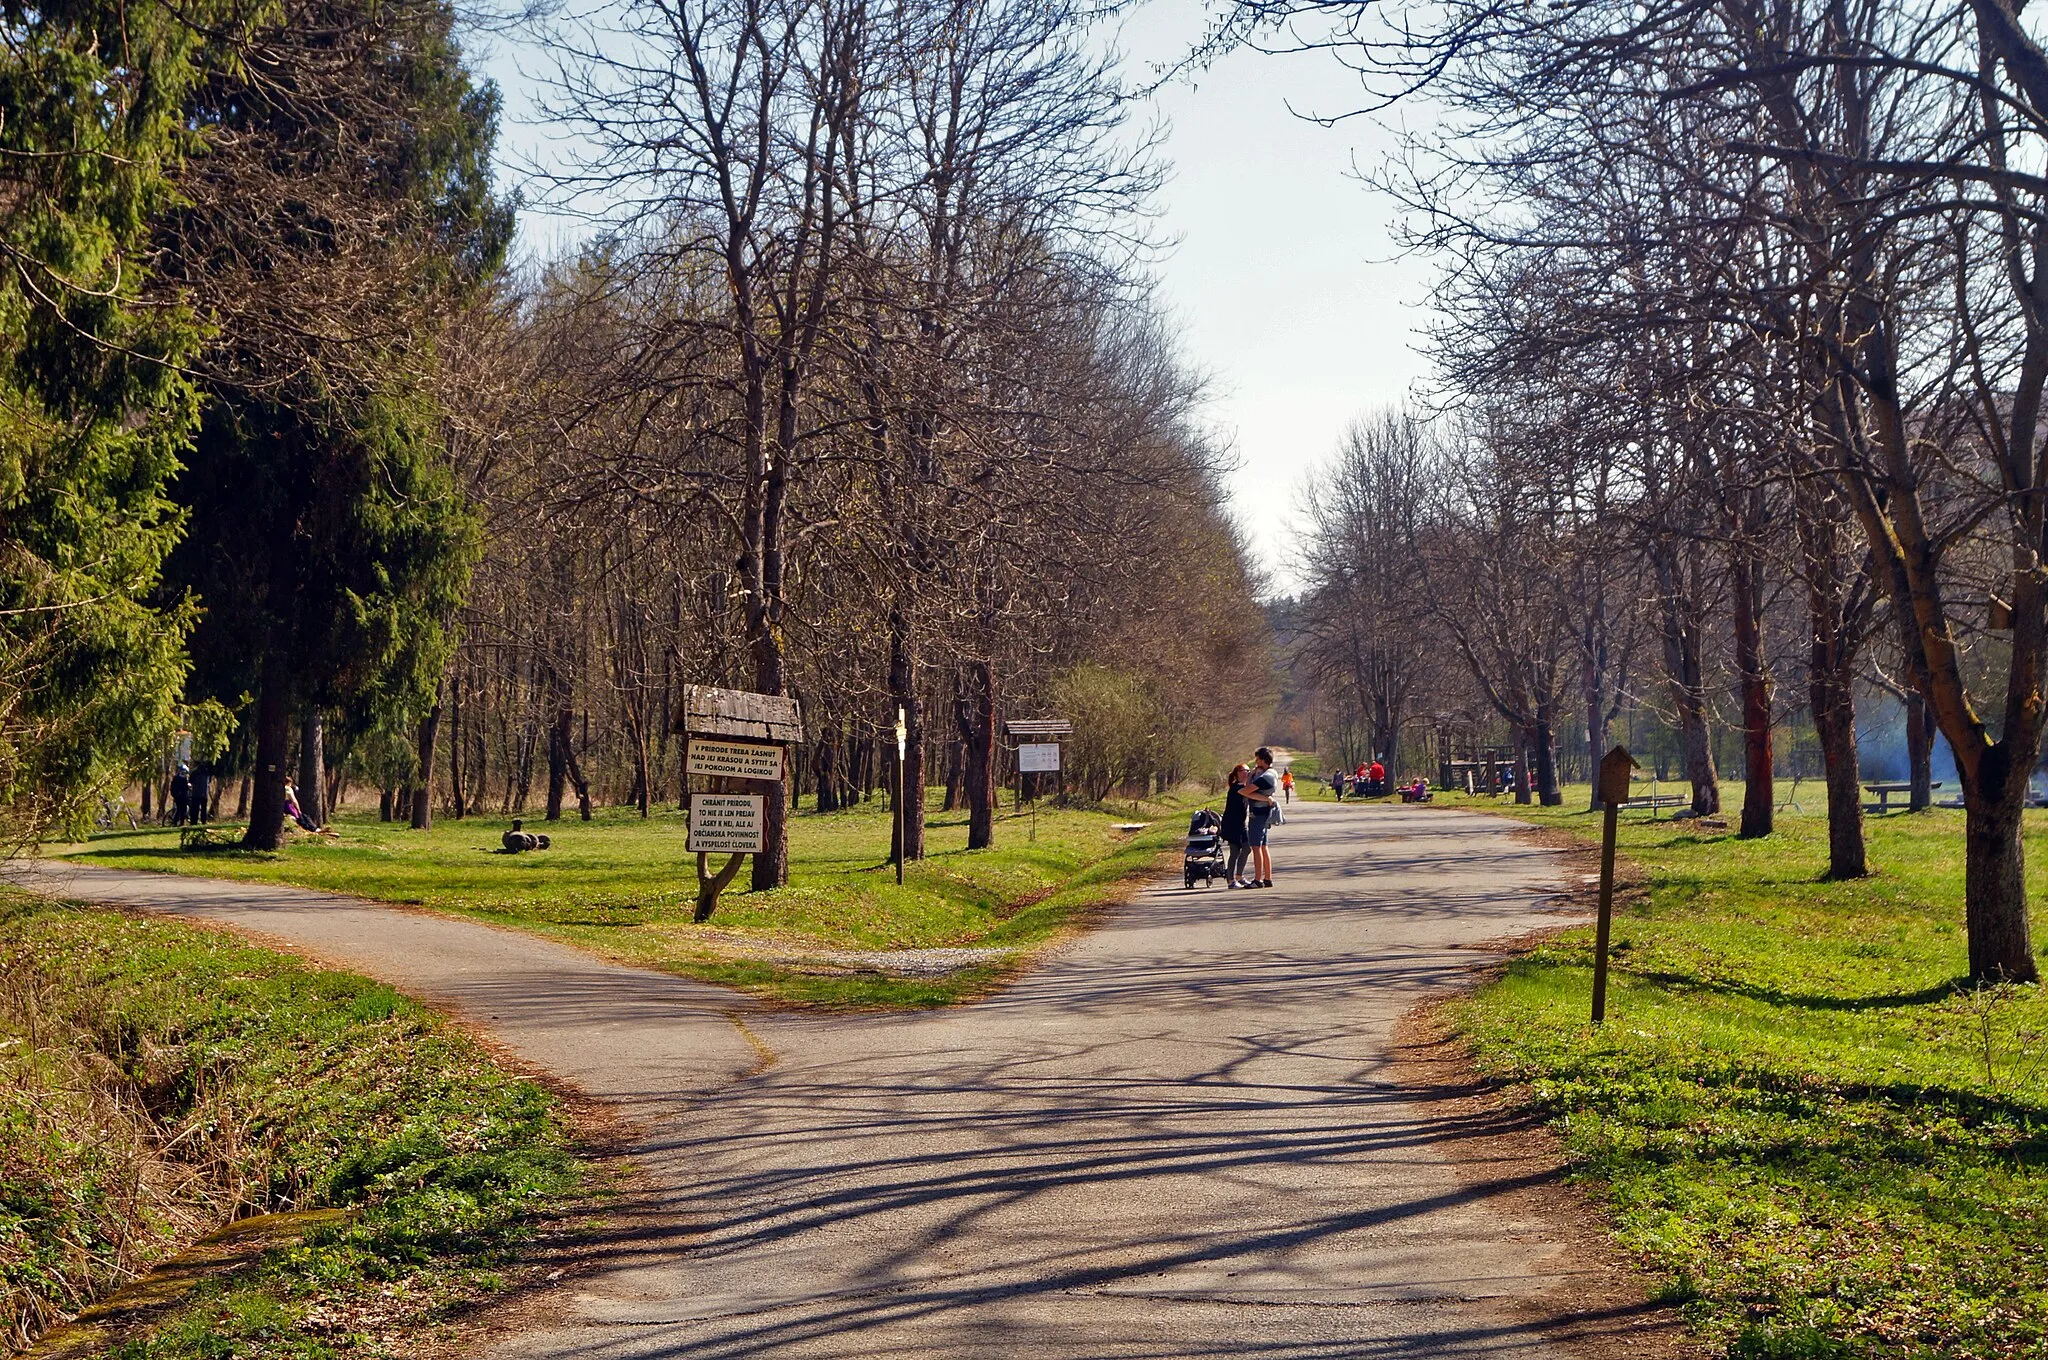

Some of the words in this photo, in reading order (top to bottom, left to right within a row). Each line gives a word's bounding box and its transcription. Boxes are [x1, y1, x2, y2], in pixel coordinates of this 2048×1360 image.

[730, 748, 749, 756] TREBA
[691, 753, 706, 761] NAD
[704, 764, 736, 773] POKOJOM
[744, 767, 773, 776] LOGIKOU
[699, 809, 707, 817] TO
[707, 809, 717, 817] NIE
[735, 810, 755, 818] PREJAV
[695, 840, 700, 848] A
